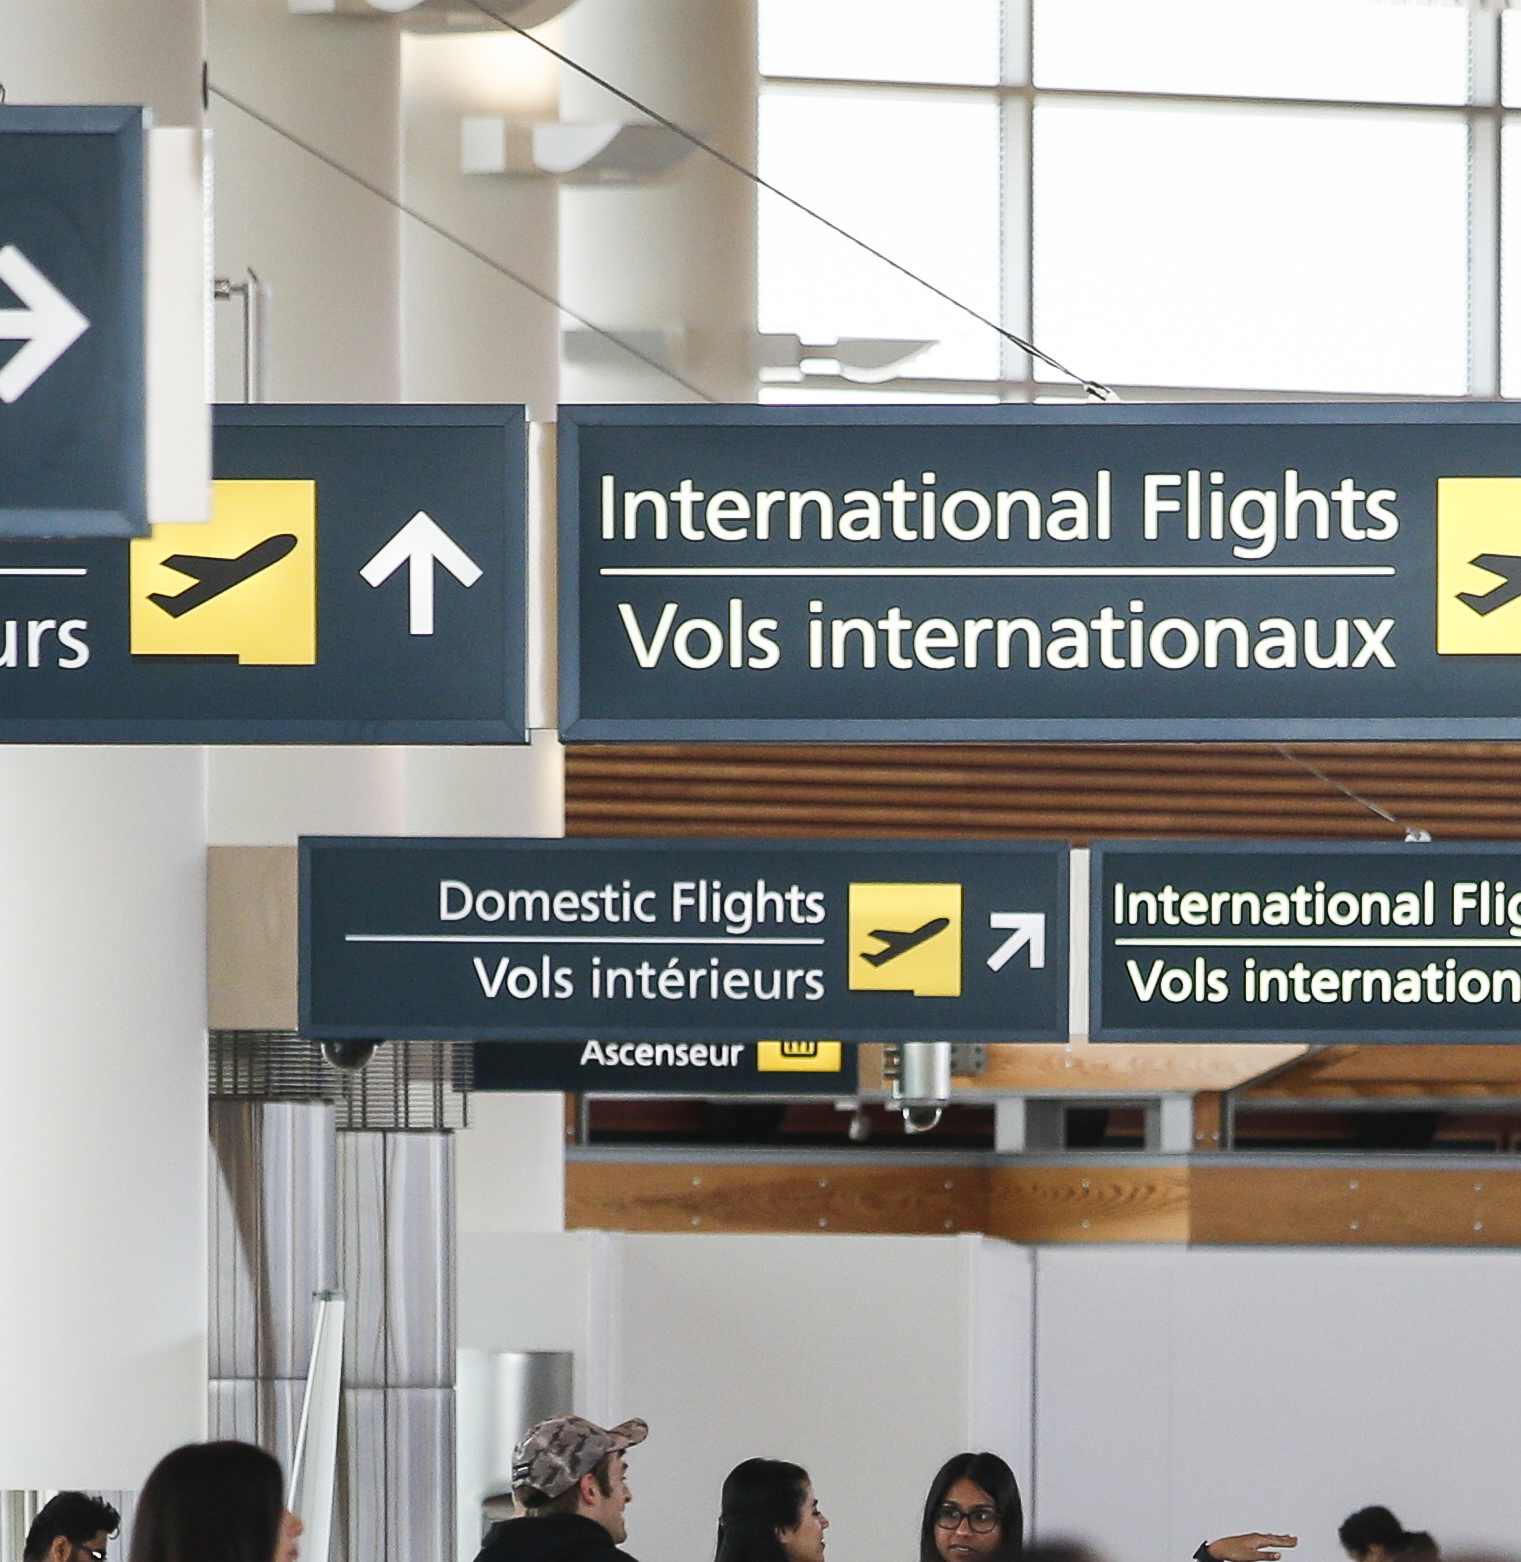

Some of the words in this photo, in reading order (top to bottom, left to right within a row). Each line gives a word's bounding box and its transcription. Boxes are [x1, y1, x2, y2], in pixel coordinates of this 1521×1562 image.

[603, 471, 1110, 540] International
[1145, 470, 1398, 558] Flights
[619, 599, 780, 668] Vols
[810, 600, 1396, 668] internationaux
[440, 880, 656, 922] Domestic
[668, 879, 825, 938] Flights
[1115, 880, 1433, 925] International
[474, 955, 573, 998] Vols
[593, 957, 824, 1000] intérieurs
[1127, 957, 1228, 1002] Vols
[580, 1040, 744, 1067] Ascenseur
